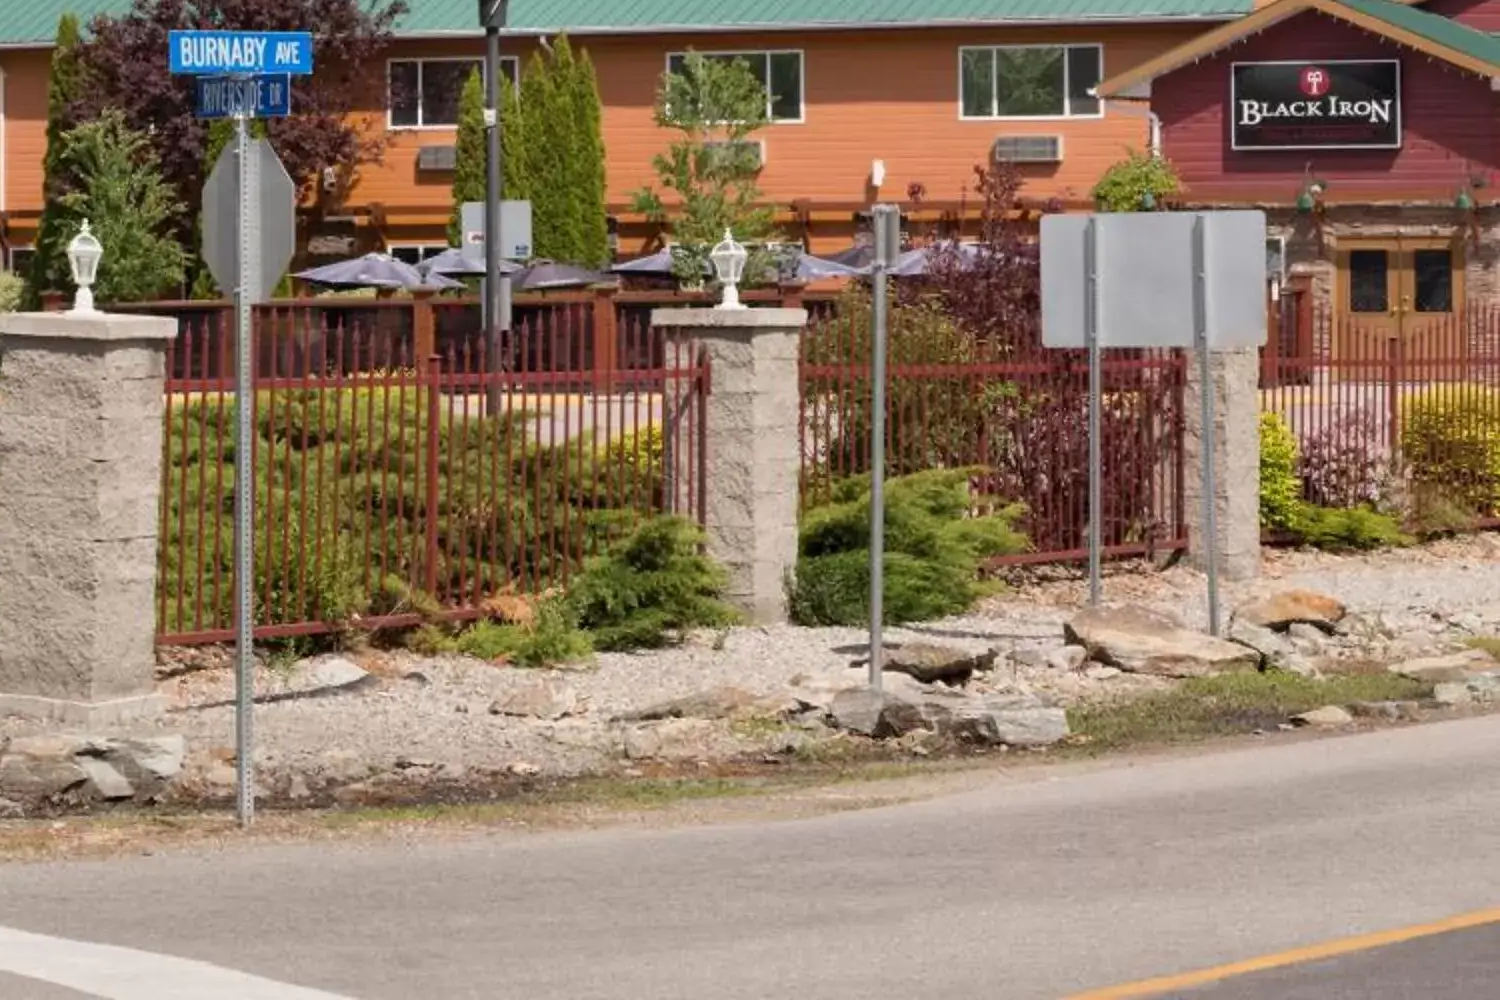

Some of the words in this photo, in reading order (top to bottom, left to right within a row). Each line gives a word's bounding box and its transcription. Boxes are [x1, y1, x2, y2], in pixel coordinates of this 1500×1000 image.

[180, 37, 266, 67] BURNABY
[275, 41, 300, 65] AVE
[203, 80, 265, 113] RIVERSDE
[1238, 99, 1323, 126] BLACK
[1327, 96, 1393, 124] IRON
